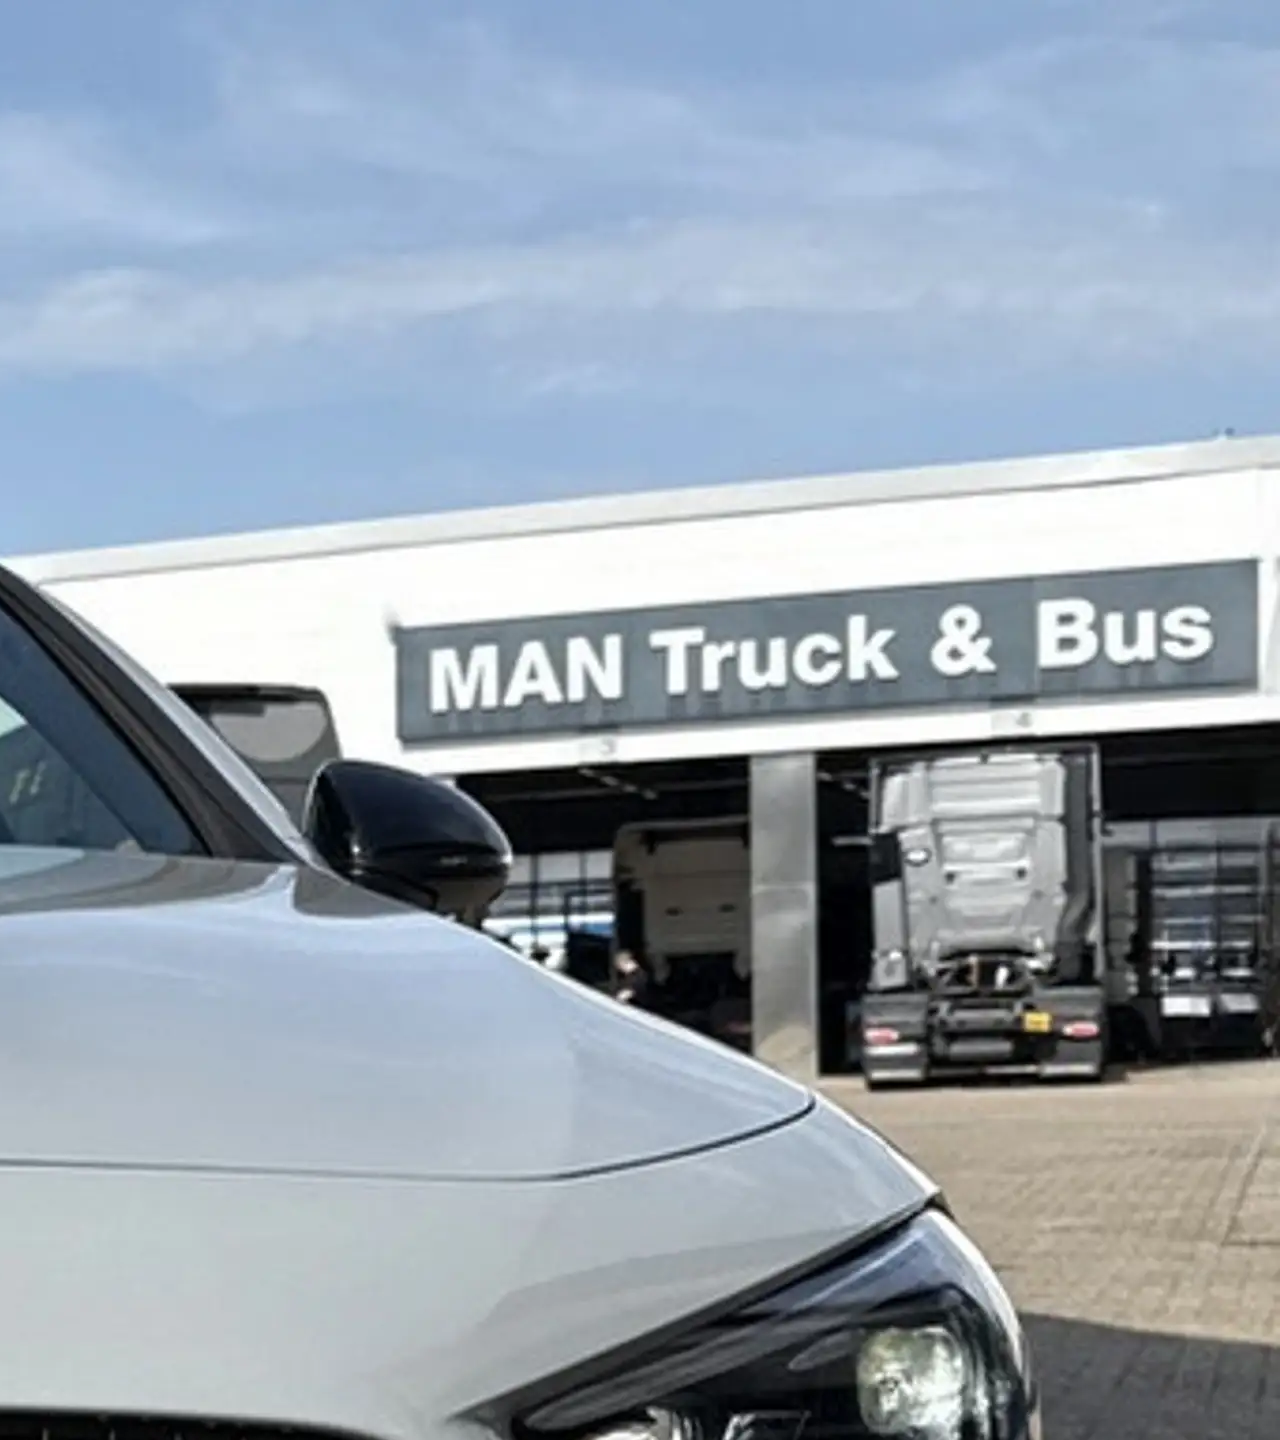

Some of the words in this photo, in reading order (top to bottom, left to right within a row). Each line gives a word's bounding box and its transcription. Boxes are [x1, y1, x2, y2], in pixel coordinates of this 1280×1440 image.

[429, 634, 623, 712] MAN
[649, 614, 899, 695] Truck
[930, 604, 996, 676] &
[1037, 597, 1214, 669] Bus
